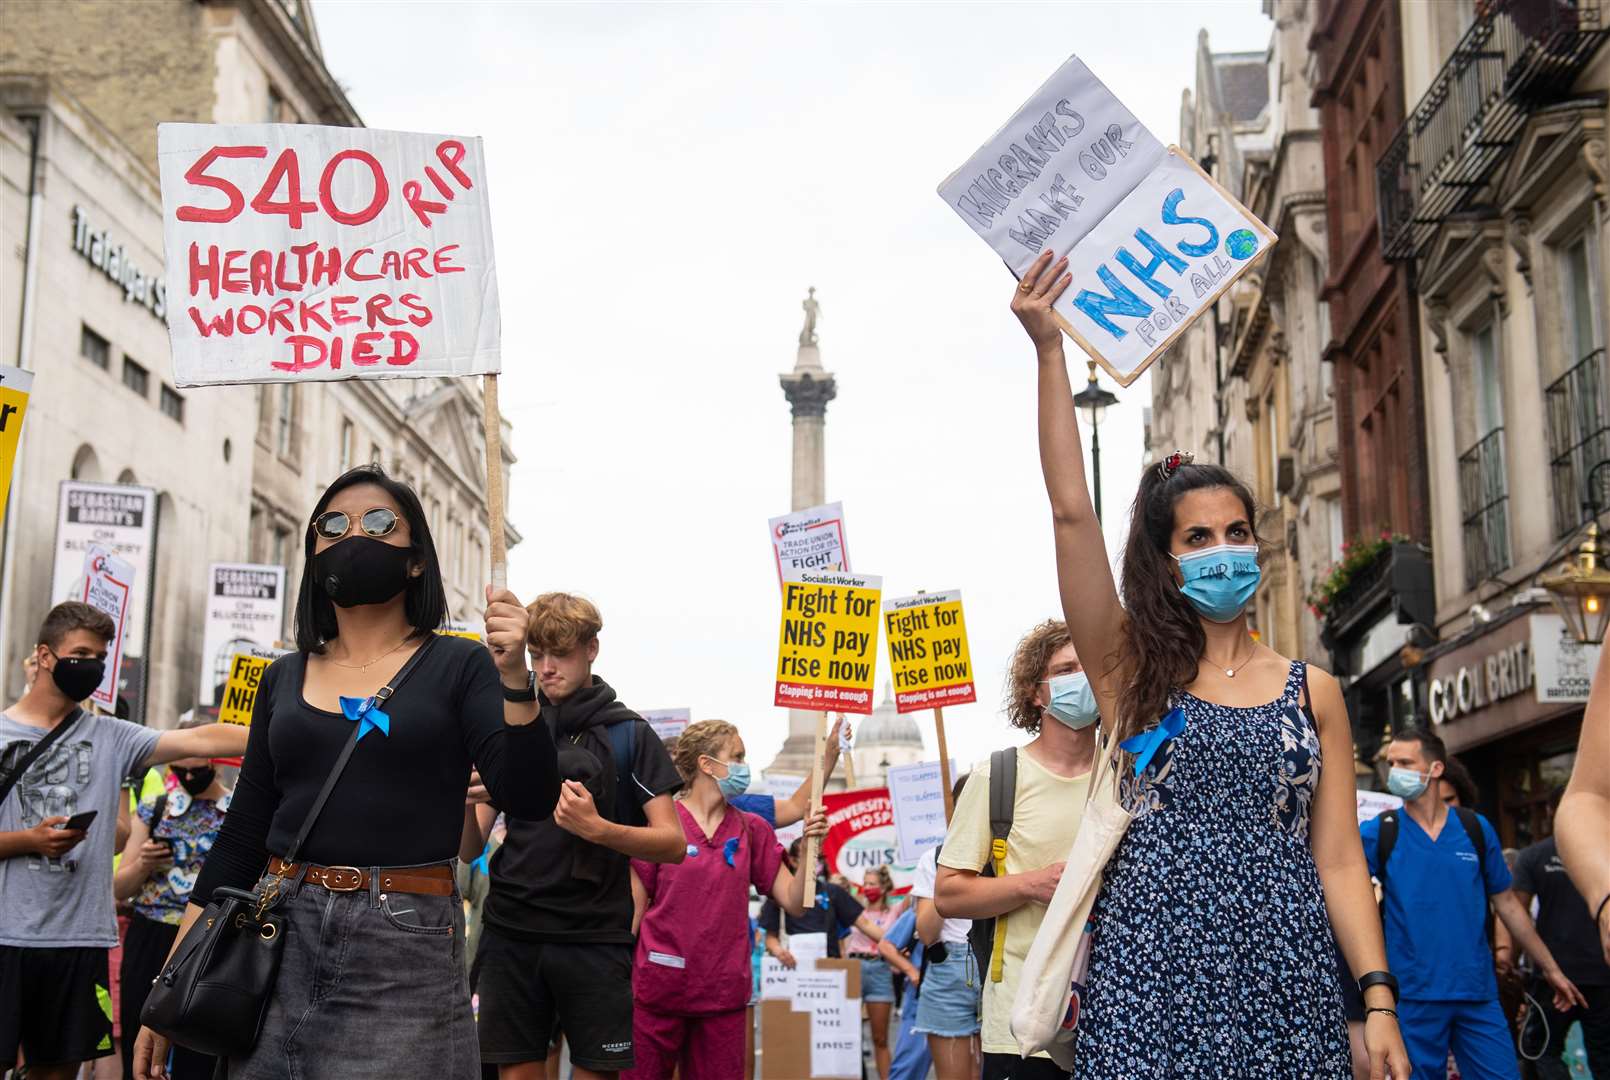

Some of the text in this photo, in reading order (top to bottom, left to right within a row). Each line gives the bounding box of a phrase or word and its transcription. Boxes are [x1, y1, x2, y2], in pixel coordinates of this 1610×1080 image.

[957, 99, 1084, 229] MIGRANTS
[176, 140, 475, 229] 540 RIP
[1009, 123, 1134, 254] MAKE OUR
[71, 204, 155, 309] Trafalgar
[188, 240, 465, 299] HEALTHCARE
[1072, 188, 1219, 342] NHS
[1135, 256, 1231, 347] FOR ALL
[188, 293, 434, 338] WORKERS
[271, 331, 420, 372] DIED
[69, 493, 143, 511] SEBASTIAN
[780, 547, 809, 557] ACTION
[811, 543, 824, 552] FOR
[783, 532, 833, 548] TRADE UNION
[792, 552, 831, 569] FIGHT
[1200, 563, 1231, 581] FAIR
[217, 570, 277, 586] SEBASTIAN
[801, 574, 866, 587] Socialist Worker
[786, 585, 875, 618] Fight for
[895, 595, 947, 609] Socialist Worker
[212, 609, 275, 621] BLUEBERRY
[886, 606, 959, 637] Fight for
[783, 619, 869, 657] NHS pay
[891, 637, 961, 662] NHS pay
[781, 651, 870, 682] rise now
[895, 662, 967, 687] rise now
[226, 687, 254, 713] NH
[779, 683, 868, 704] Clapping is not enough
[898, 692, 928, 704] Clapping
[928, 690, 935, 699] is
[935, 688, 947, 698] not
[948, 684, 972, 697] enough
[1429, 663, 1484, 725] COOL
[846, 848, 900, 867] UNIS
